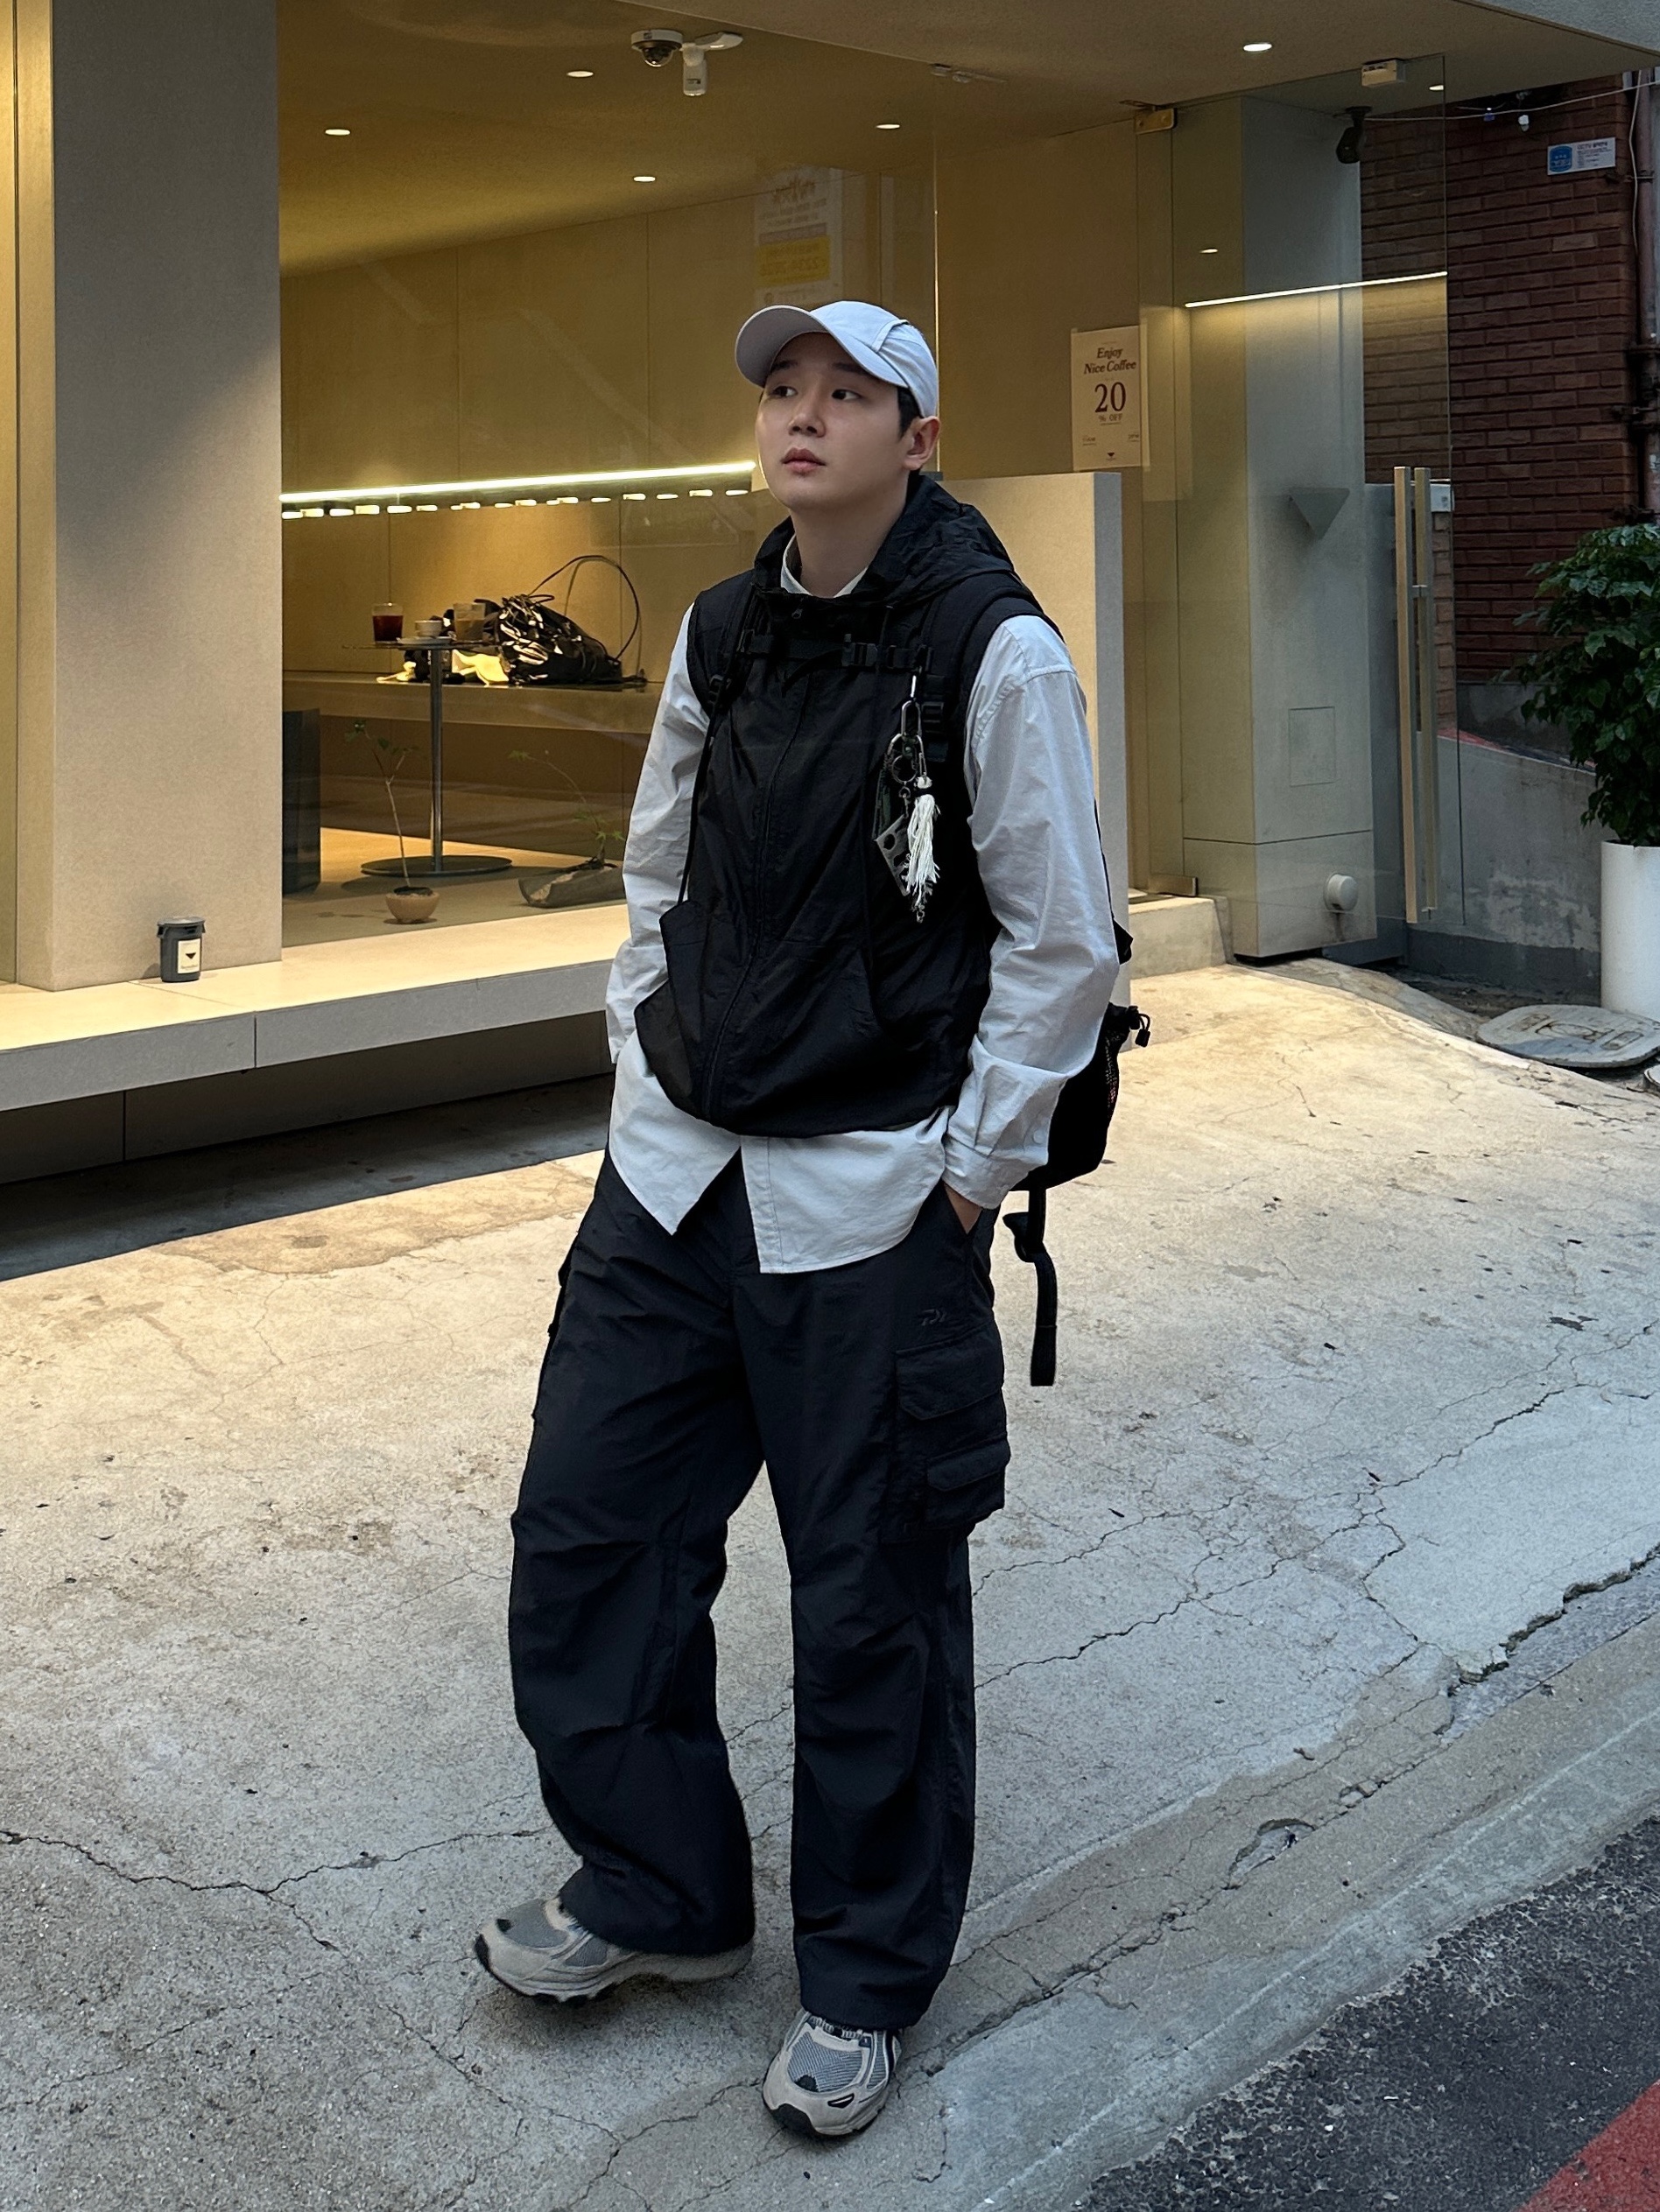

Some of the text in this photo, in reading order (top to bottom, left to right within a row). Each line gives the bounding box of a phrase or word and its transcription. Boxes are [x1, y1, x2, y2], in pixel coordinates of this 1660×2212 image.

[1097, 347, 1123, 360] Enjoy
[1084, 359, 1136, 375] Nice Coffee
[1094, 381, 1126, 413] 20
[1108, 412, 1123, 422] OFF
